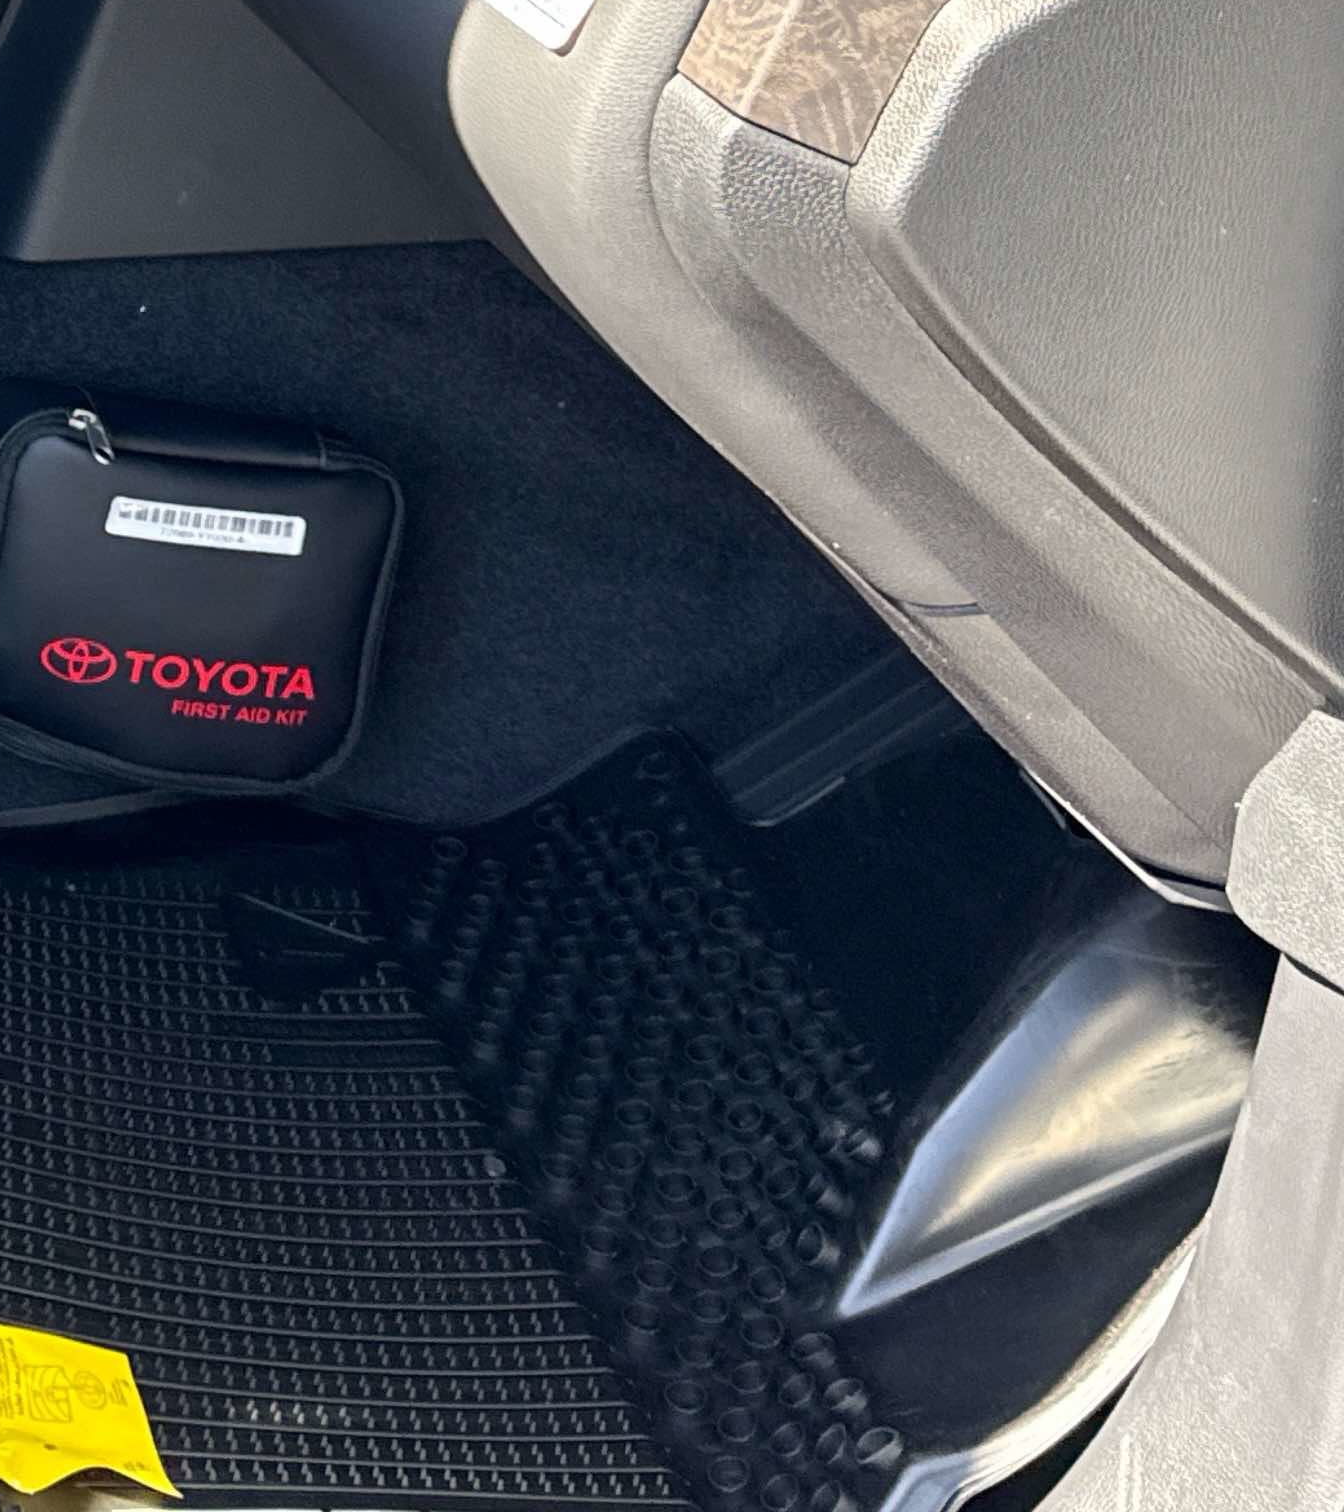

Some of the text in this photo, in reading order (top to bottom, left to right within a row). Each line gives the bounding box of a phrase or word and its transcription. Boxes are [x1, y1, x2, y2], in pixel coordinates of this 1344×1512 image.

[124, 650, 316, 701] TOYOTA
[171, 698, 309, 727] FIRST AID KIT
